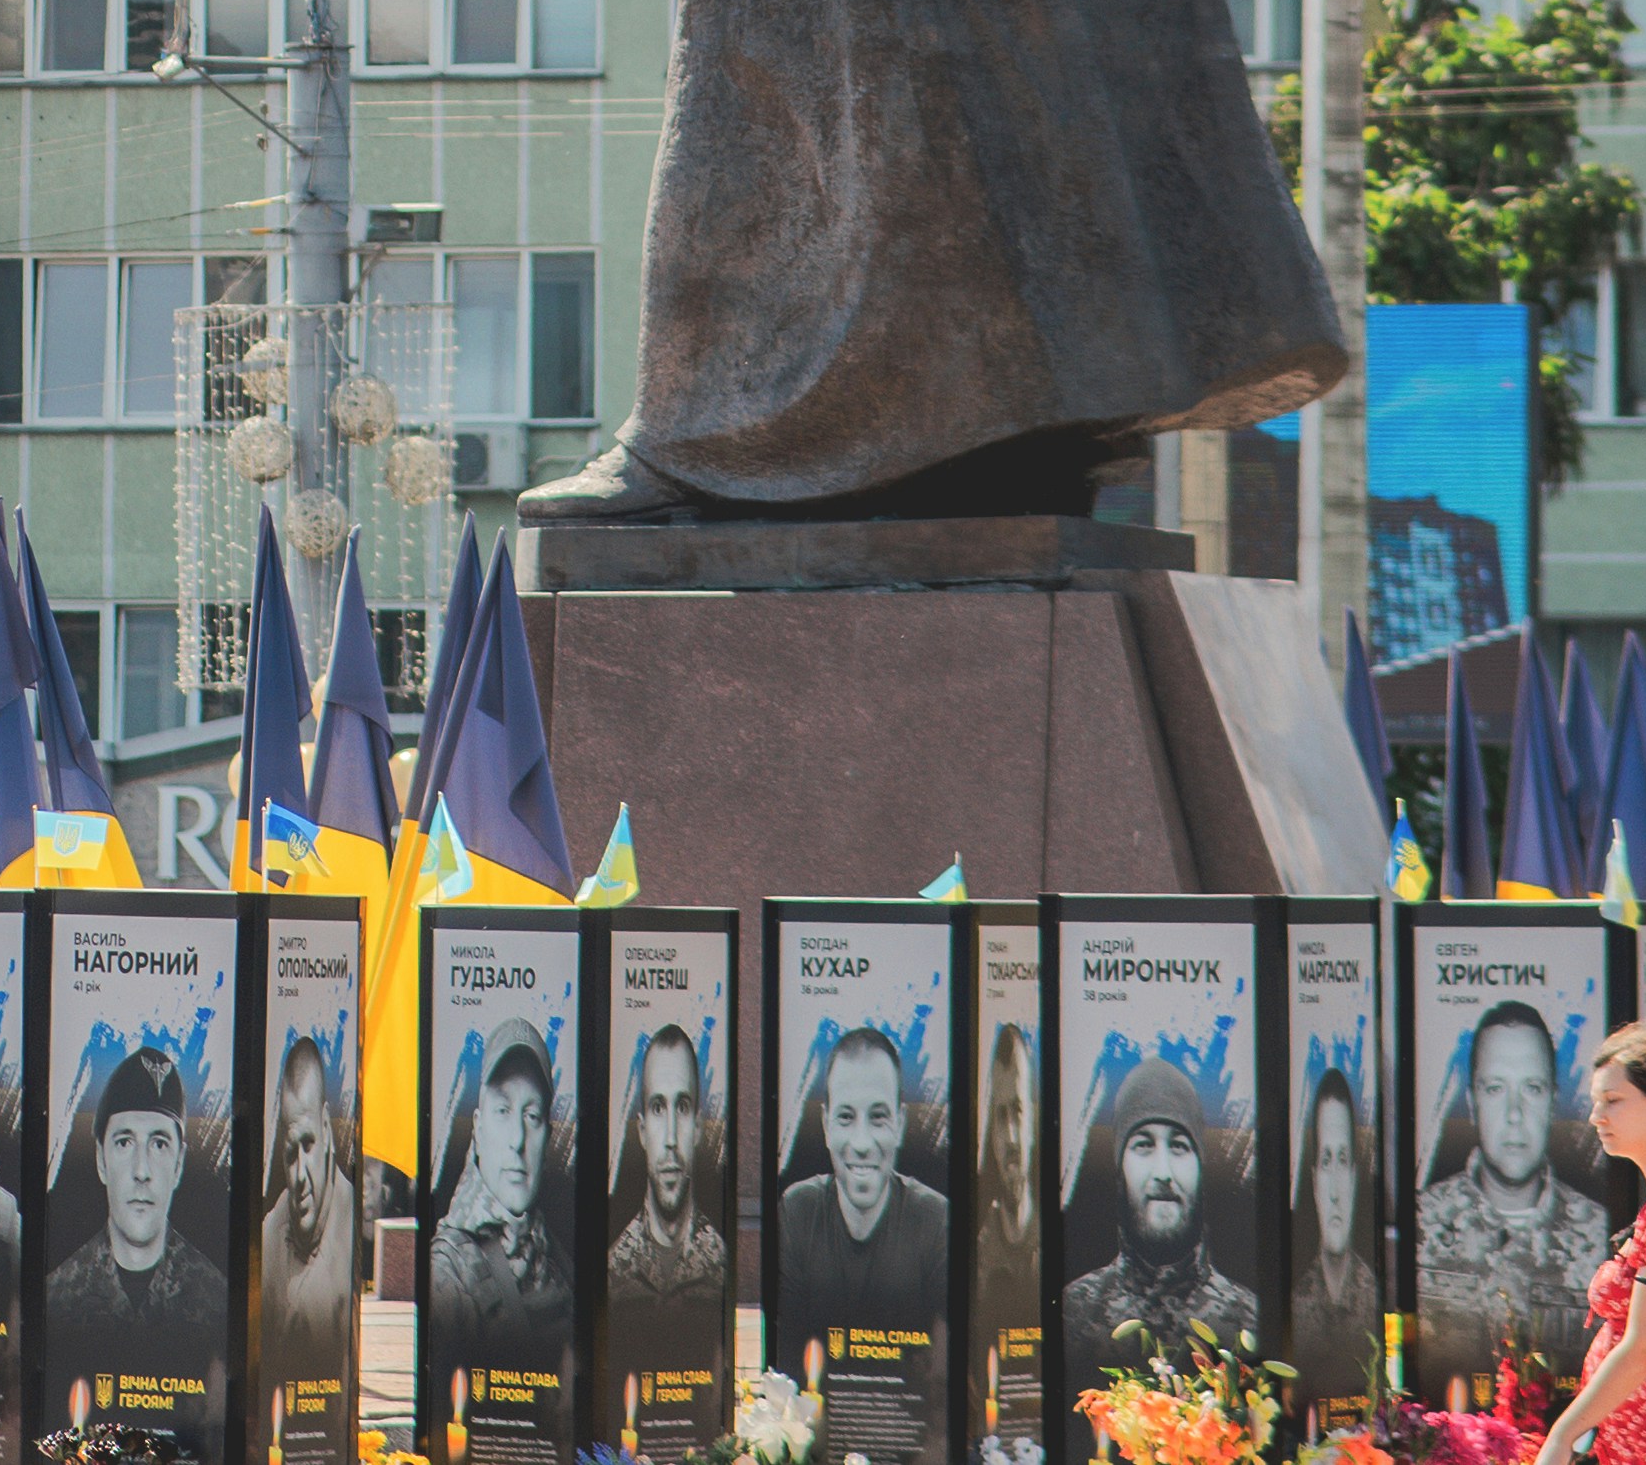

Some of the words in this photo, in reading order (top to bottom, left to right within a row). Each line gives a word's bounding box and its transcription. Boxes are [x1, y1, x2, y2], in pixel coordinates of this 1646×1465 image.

[74, 931, 127, 947] ВАСИЛЬ
[278, 936, 307, 951] ДМИТРО
[800, 937, 848, 951] БОГДАН
[1083, 936, 1134, 954] АНДРІЙ
[451, 945, 496, 960] МИКОЛА
[625, 947, 677, 963] ОЛЕКСАНДР
[1436, 943, 1478, 956] ЄВГЕН
[74, 947, 199, 975] НАГОРНИЙ
[278, 954, 348, 979] ОПОЛЬСЬКИЙ
[801, 957, 870, 978] КУХАР
[451, 964, 536, 992] ГУДЗАЛО
[625, 968, 689, 990] МАТЕЯШ
[1083, 960, 1222, 984] МИРОНЧУК
[1437, 963, 1545, 987] ХРИСТИЧ
[73, 980, 83, 991] 41
[85, 980, 101, 993] рік
[1098, 989, 1127, 1002] років
[849, 1328, 886, 1345] ВІЧНА
[887, 1330, 931, 1347] СЛАВА
[849, 1344, 902, 1360] ГЕРОЯМ!
[119, 1374, 159, 1393] ВІЧНА
[160, 1376, 206, 1395] СЛАВА
[489, 1369, 521, 1387] ВІЧНА
[522, 1371, 559, 1389] СЛАВА
[655, 1370, 682, 1385] ВІЧНА
[683, 1371, 714, 1386] СЛАВА
[118, 1392, 175, 1410] ГЕРОЯМ!
[489, 1386, 535, 1403] ГЕРОЯМ!
